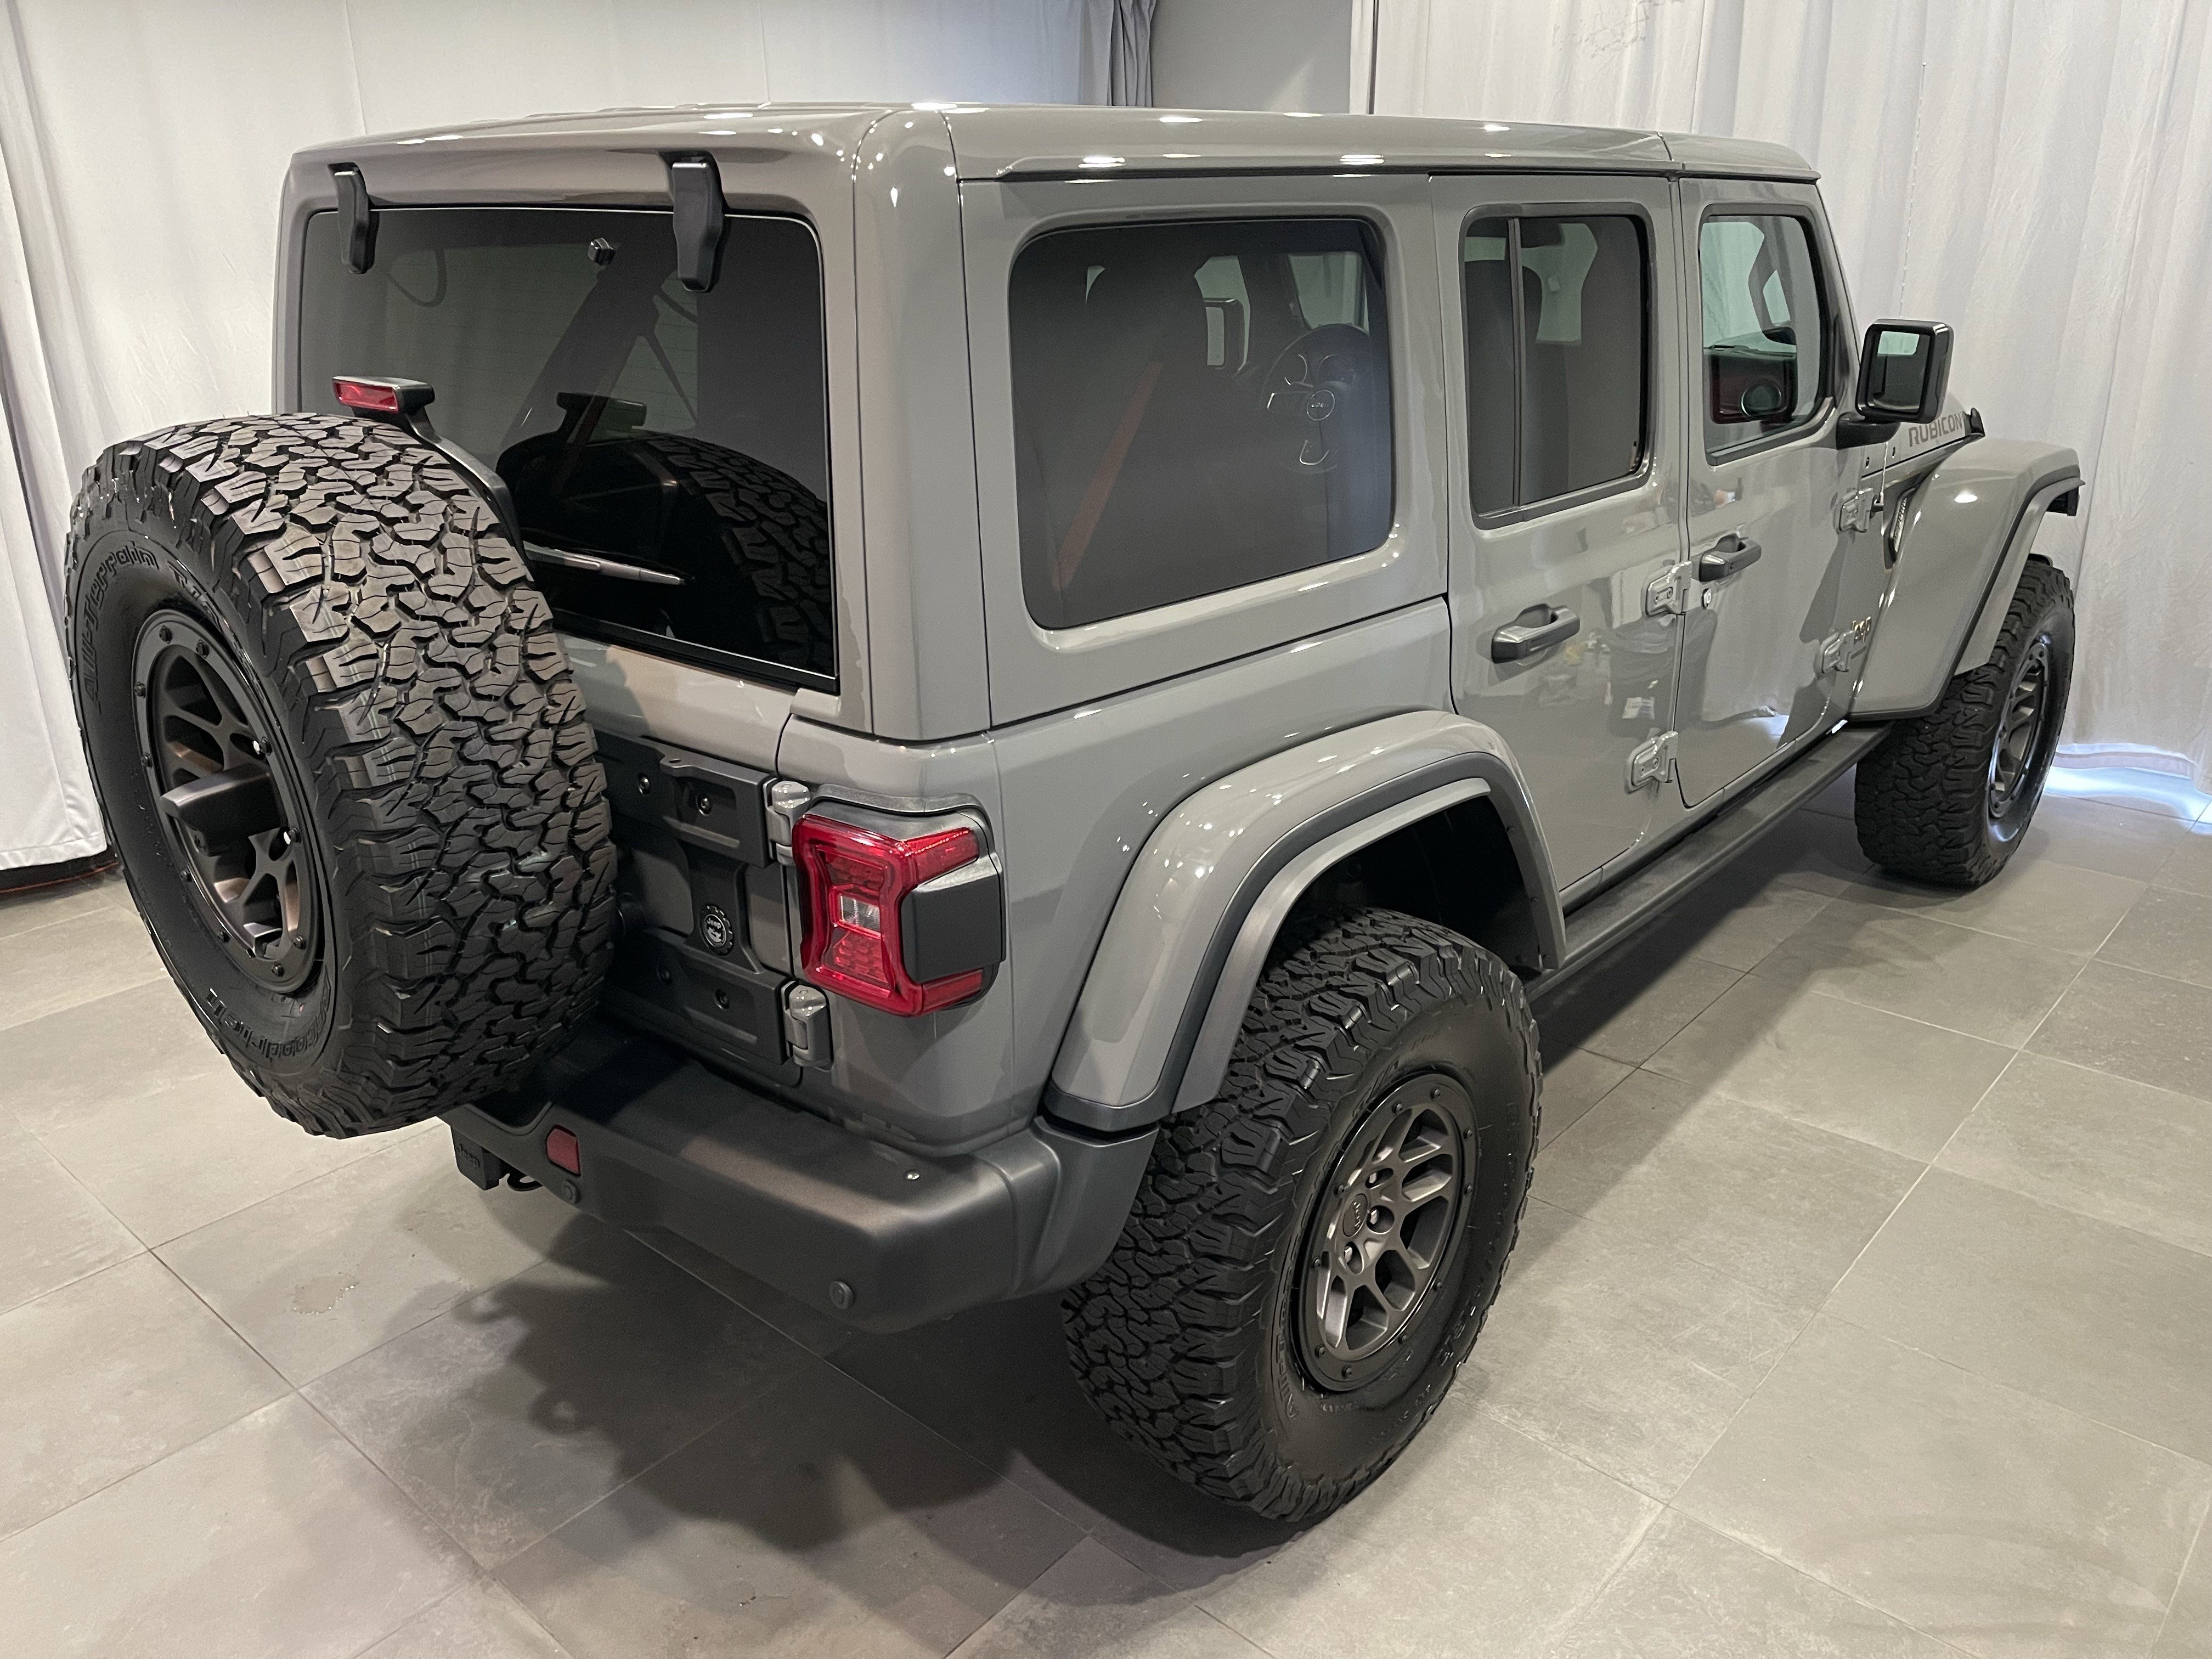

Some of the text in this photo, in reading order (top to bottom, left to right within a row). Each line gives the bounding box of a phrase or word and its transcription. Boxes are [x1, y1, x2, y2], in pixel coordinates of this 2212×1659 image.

[1908, 412, 1963, 447] RUBICON
[706, 917, 721, 929] Jeep
[456, 1142, 481, 1170] Jeep
